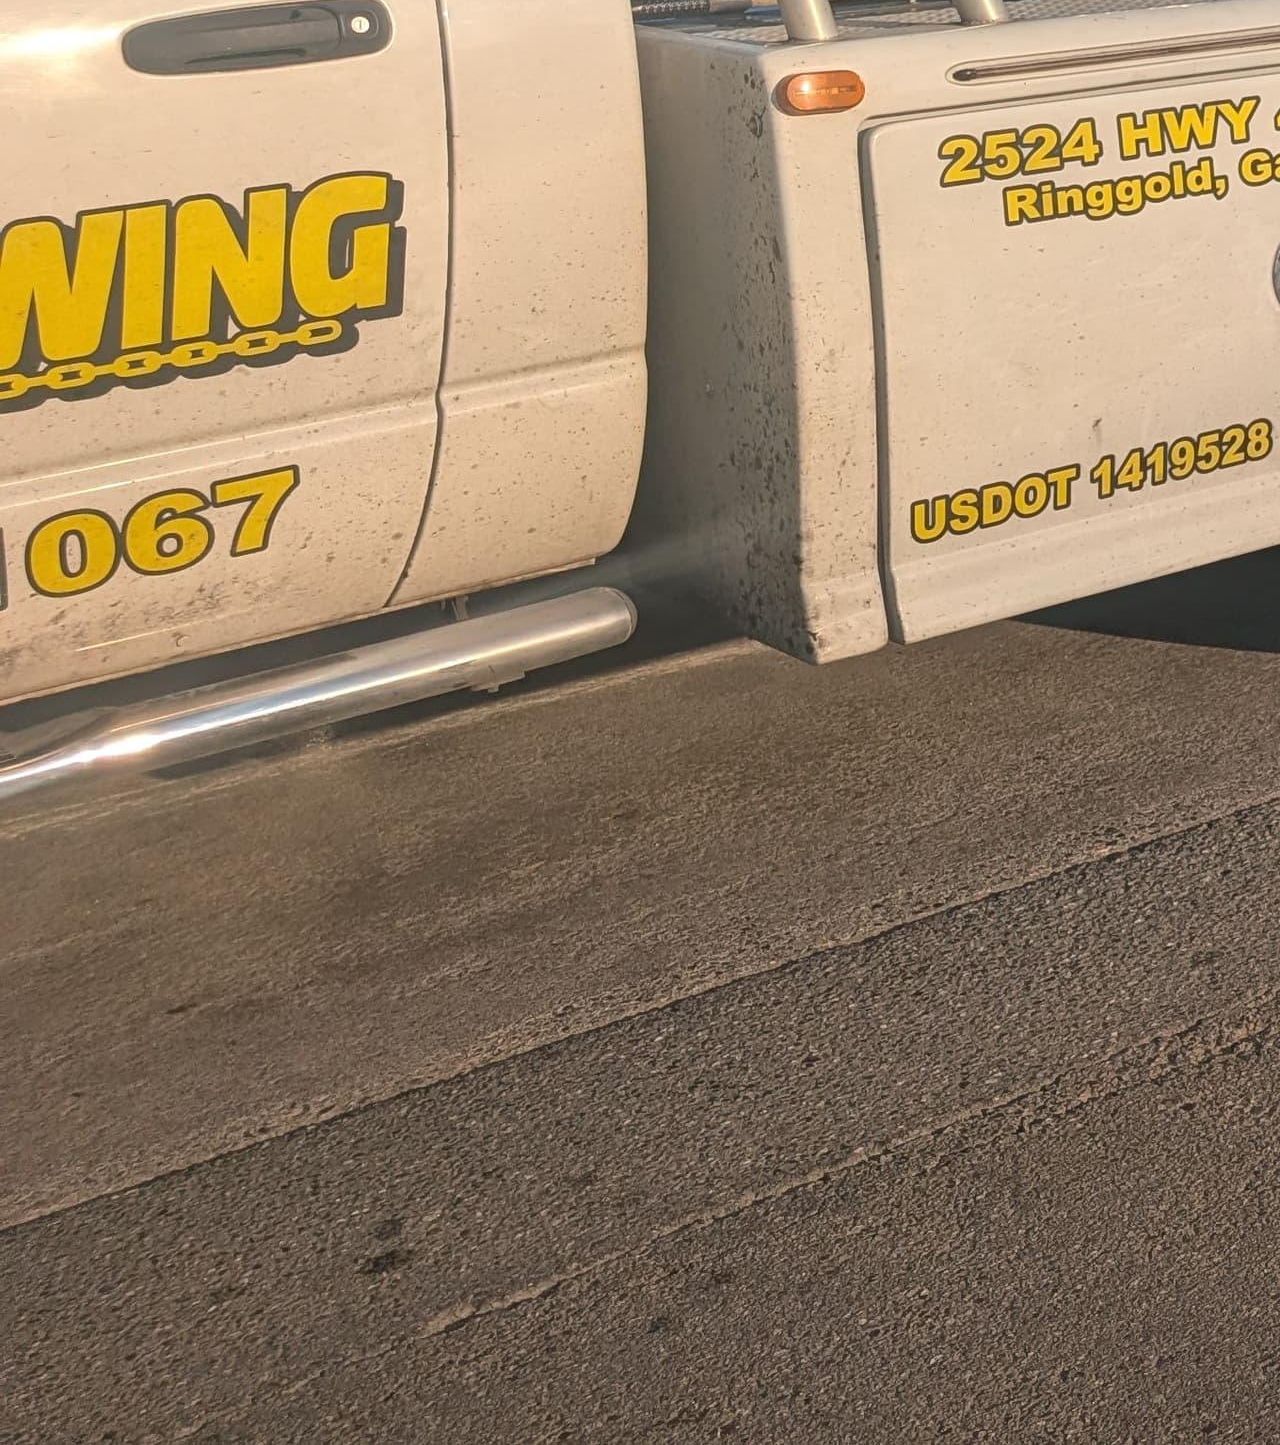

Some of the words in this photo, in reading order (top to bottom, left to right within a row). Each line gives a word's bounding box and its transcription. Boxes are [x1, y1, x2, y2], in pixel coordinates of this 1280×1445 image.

[938, 117, 1101, 186] 2524
[1117, 96, 1261, 159] HWY
[1003, 160, 1229, 226] Ringgold,
[911, 465, 1081, 543] USDOT
[1090, 418, 1274, 500] 1419528
[0, 465, 300, 610] 067
